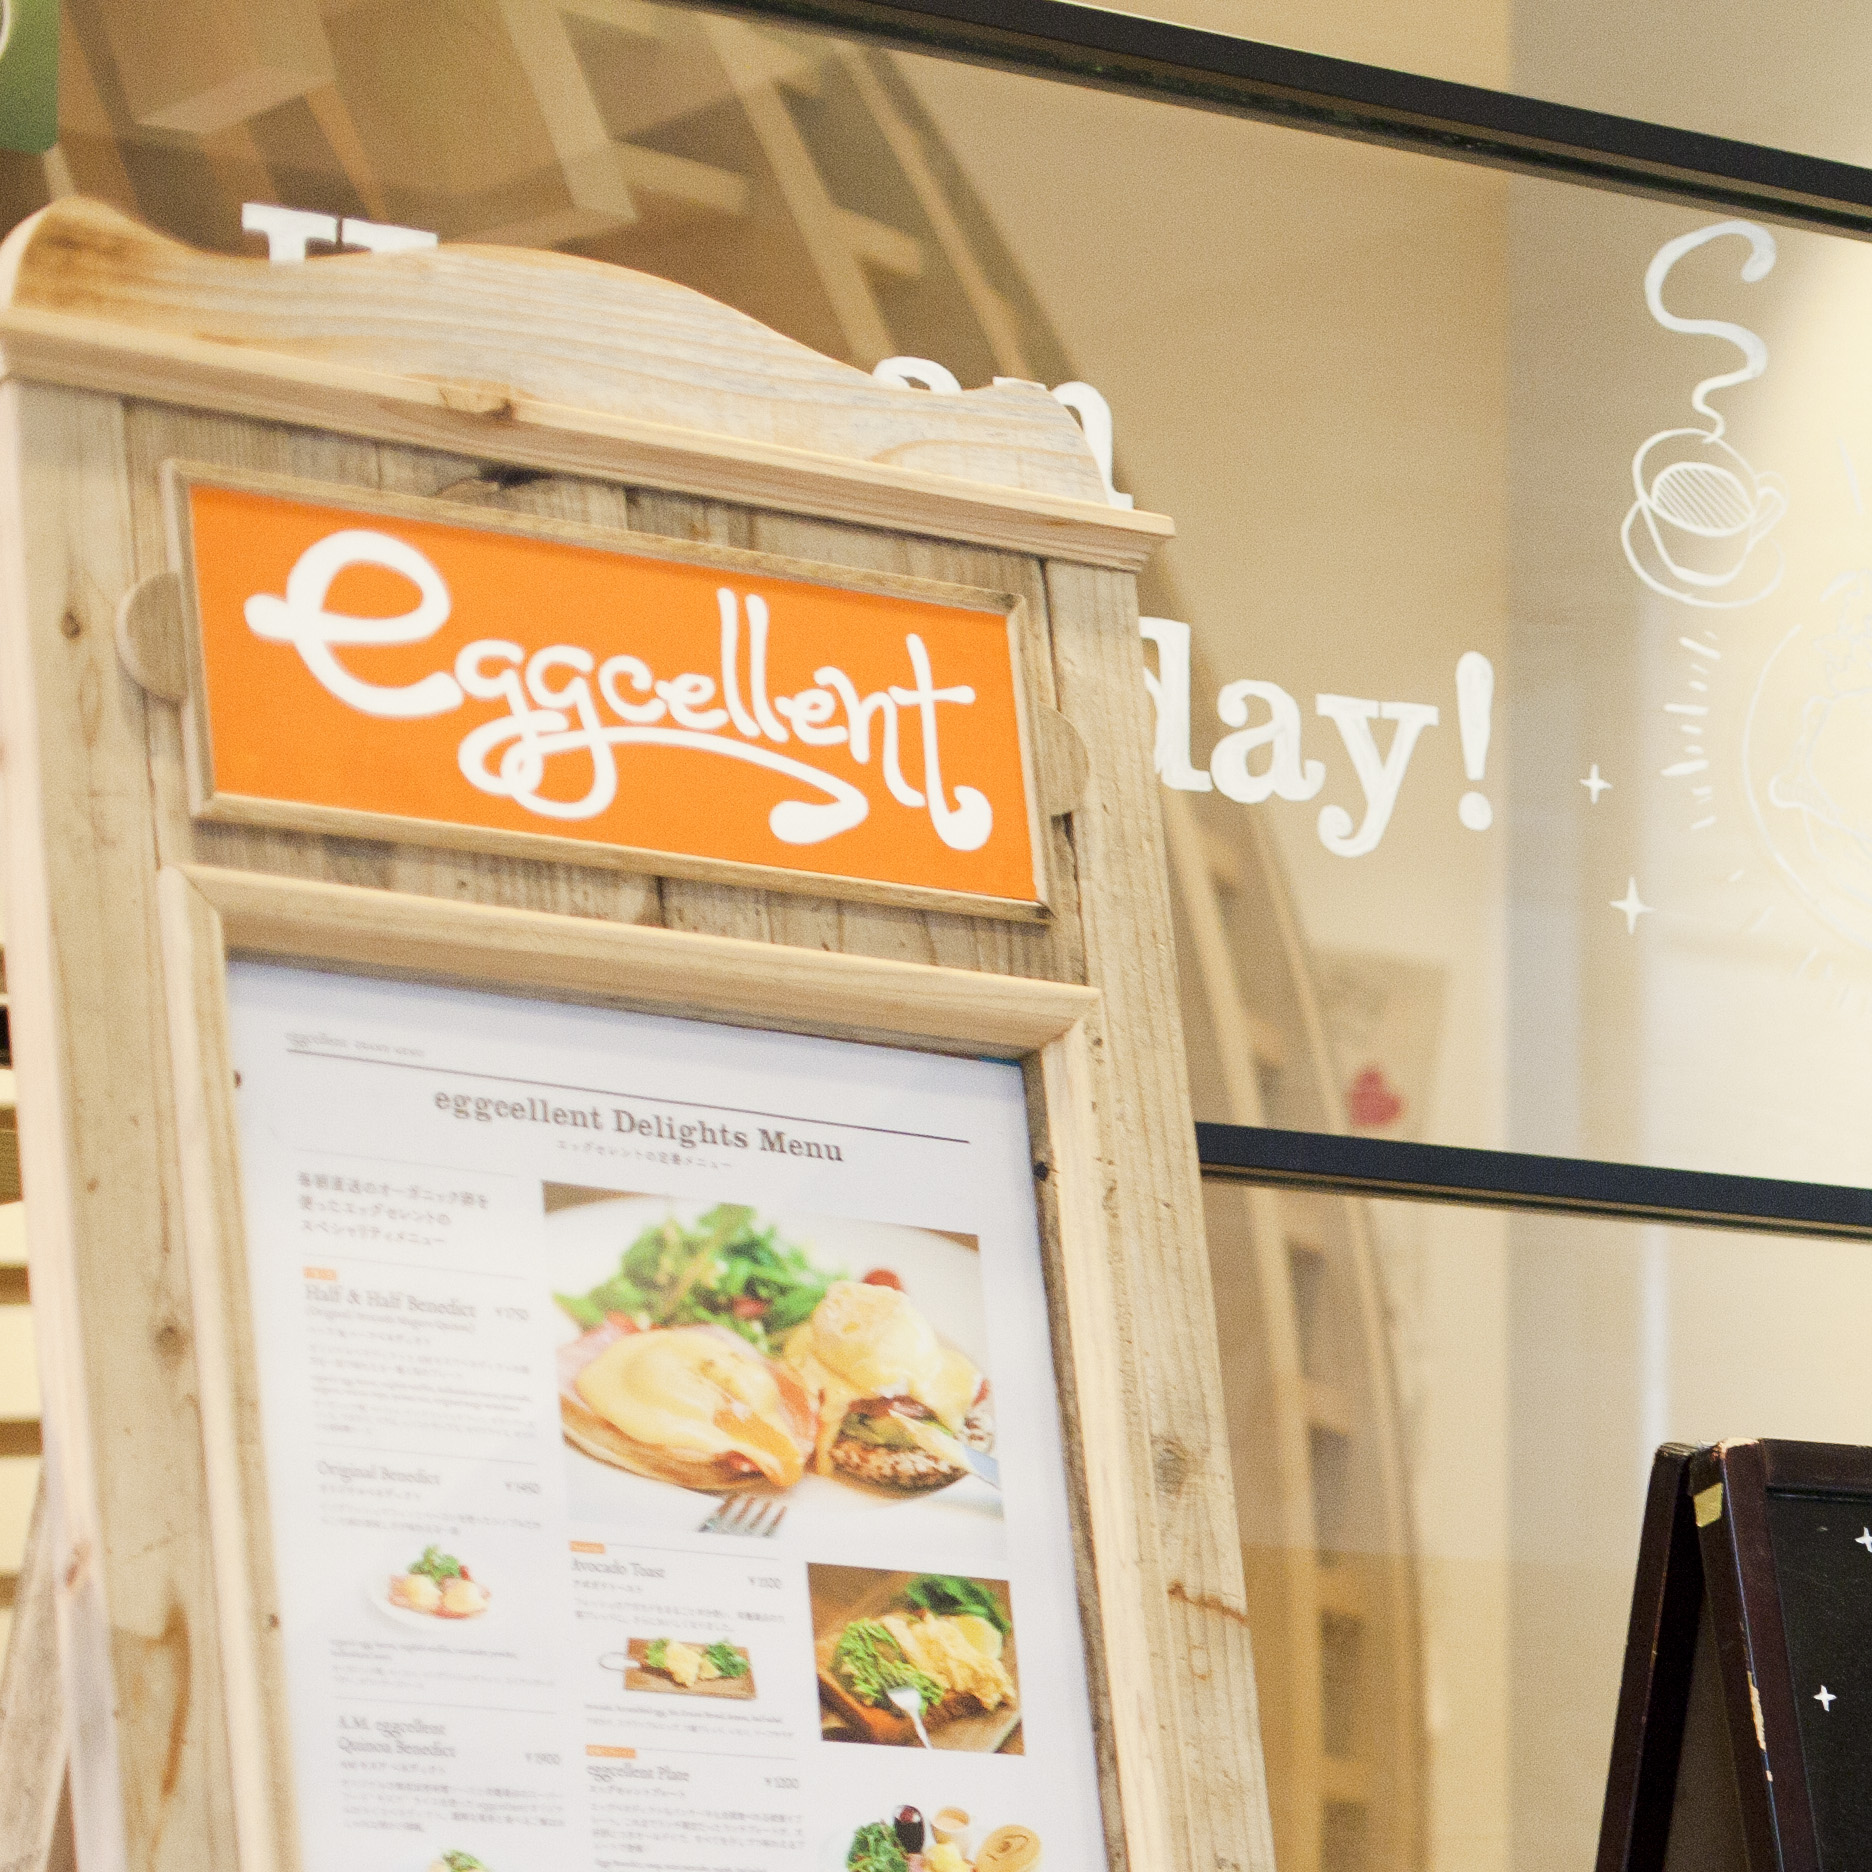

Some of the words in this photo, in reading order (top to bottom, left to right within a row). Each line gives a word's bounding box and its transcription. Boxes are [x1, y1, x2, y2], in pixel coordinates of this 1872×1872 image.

[435, 1090, 603, 1131] eggcellent
[612, 1107, 748, 1150] Delights
[757, 1128, 846, 1162] Menu
